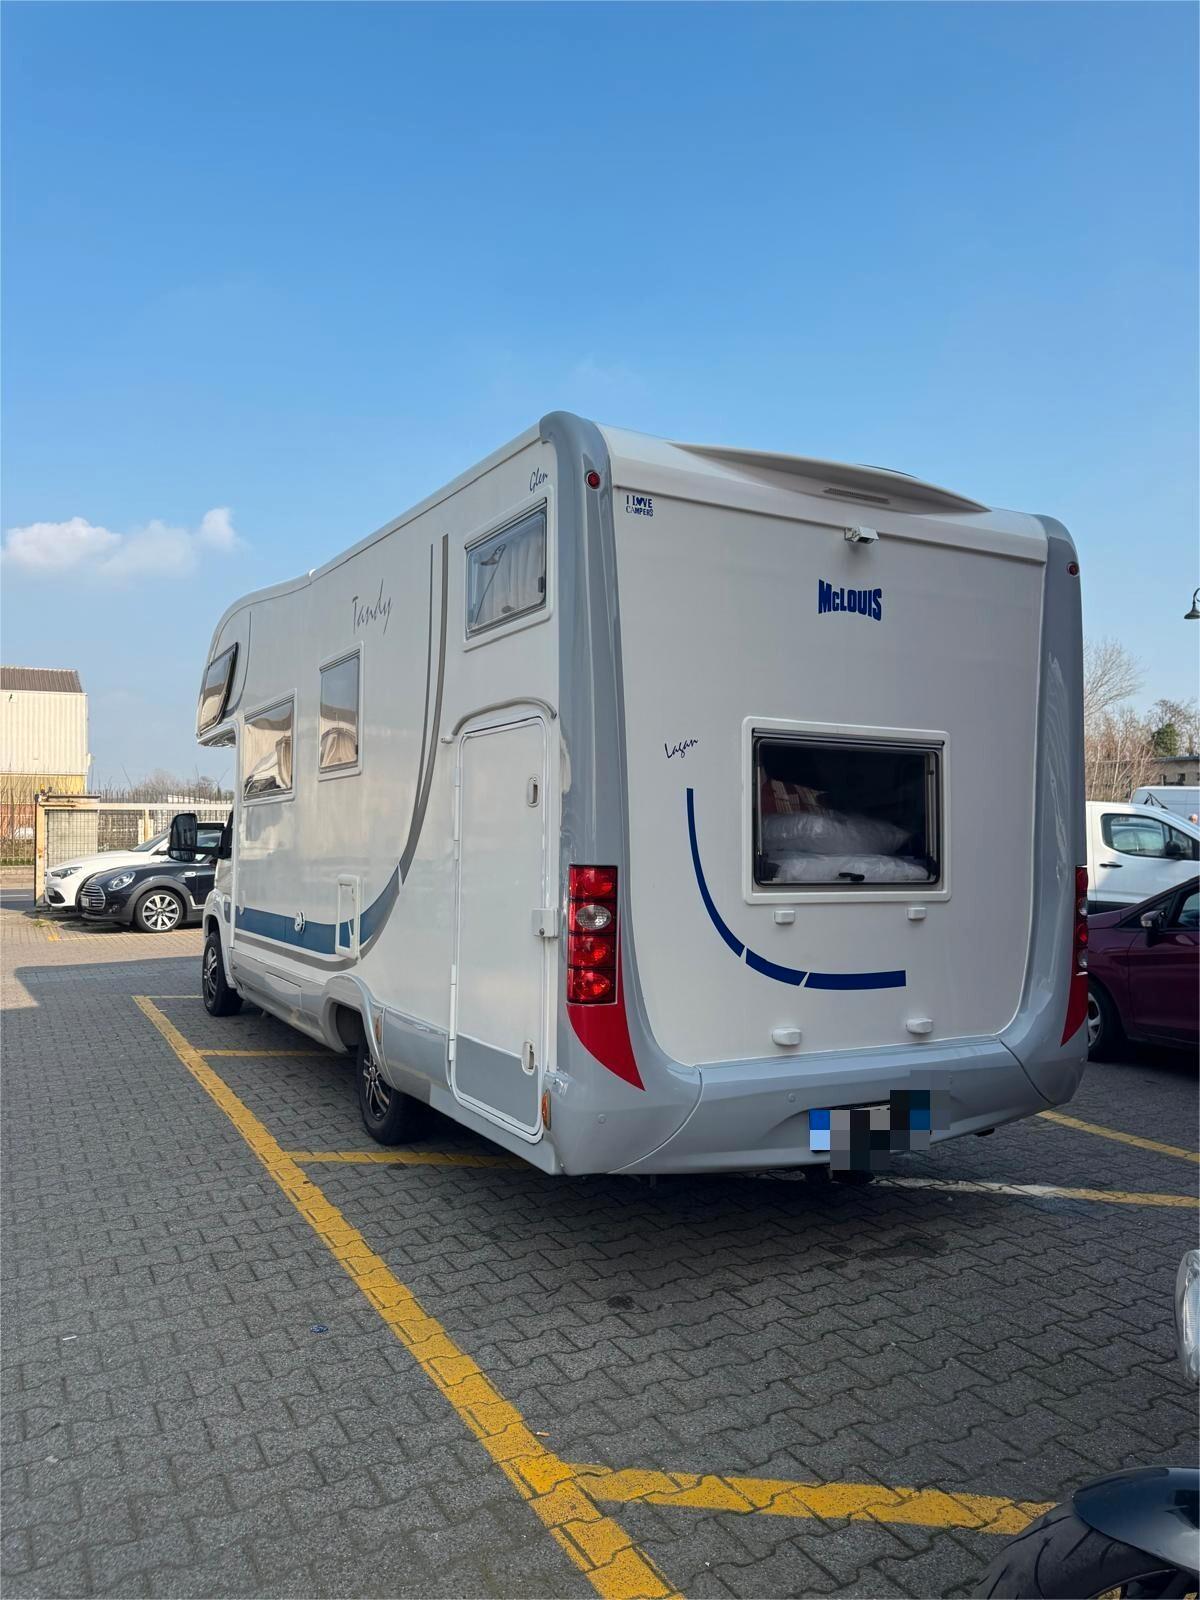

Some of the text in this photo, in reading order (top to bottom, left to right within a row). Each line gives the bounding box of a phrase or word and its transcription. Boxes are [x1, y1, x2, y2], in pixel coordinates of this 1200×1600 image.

[626, 494, 630, 505] I
[625, 505, 654, 517] CAMPERS
[352, 578, 392, 635] Tandy
[664, 739, 699, 759] Lagan
